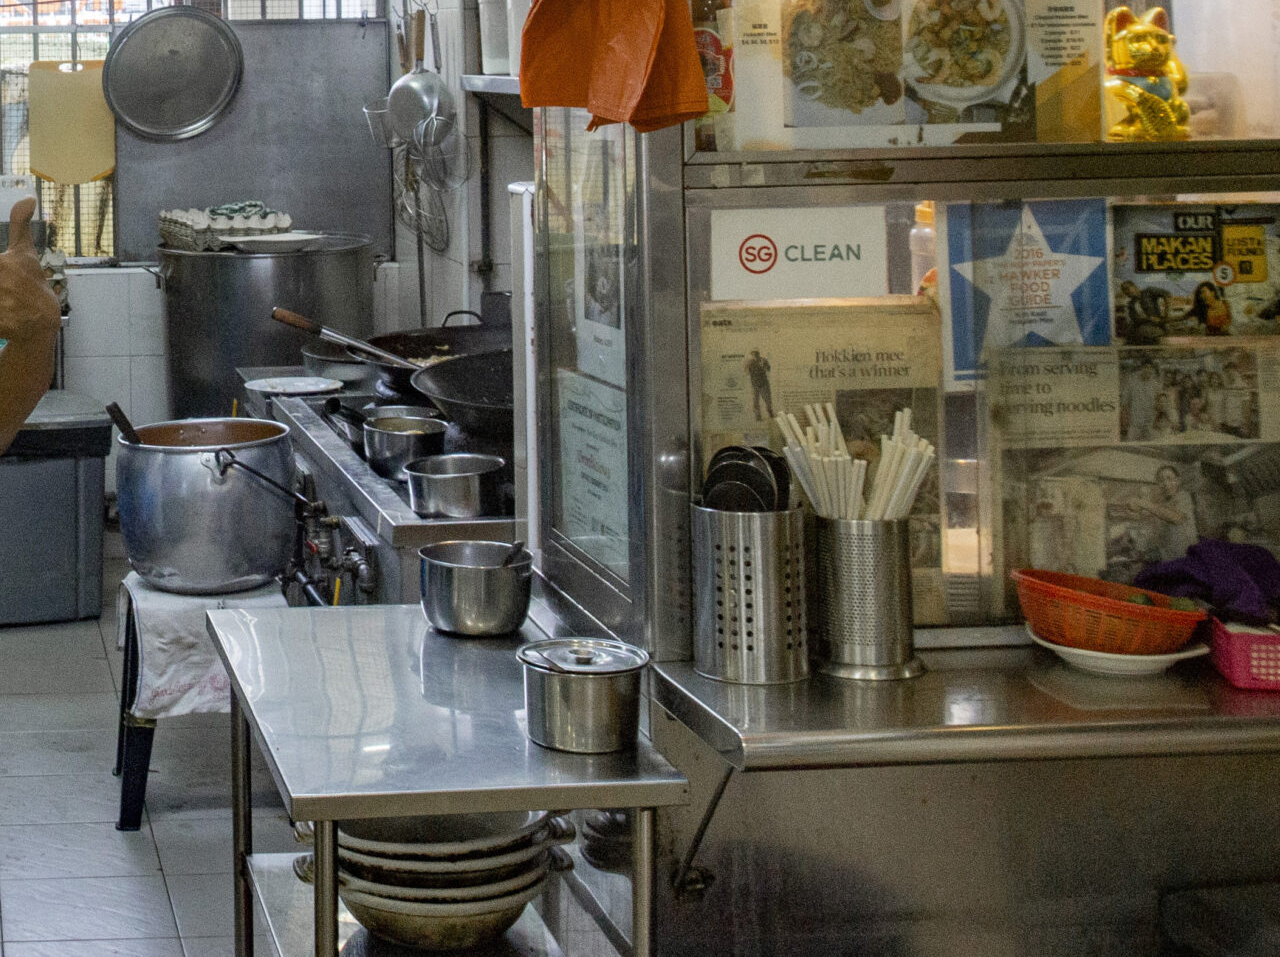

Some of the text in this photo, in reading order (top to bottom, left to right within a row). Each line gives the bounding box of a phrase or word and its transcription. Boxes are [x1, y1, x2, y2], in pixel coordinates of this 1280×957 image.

[1177, 216, 1213, 228] OUR
[1141, 237, 1213, 253] MAKAN
[744, 243, 861, 264] SG CLEAN
[1015, 248, 1043, 260] 2016
[1142, 254, 1214, 270] PLACES
[1000, 269, 1061, 280] HAWKER
[1010, 283, 1050, 292] FOOD
[1009, 294, 1052, 306] GUIDE
[815, 346, 904, 363] Hokkien mee
[809, 364, 911, 380] that's a winner
[1048, 362, 1097, 377] serving
[1036, 382, 1052, 394] to
[1056, 398, 1115, 413] noodles
